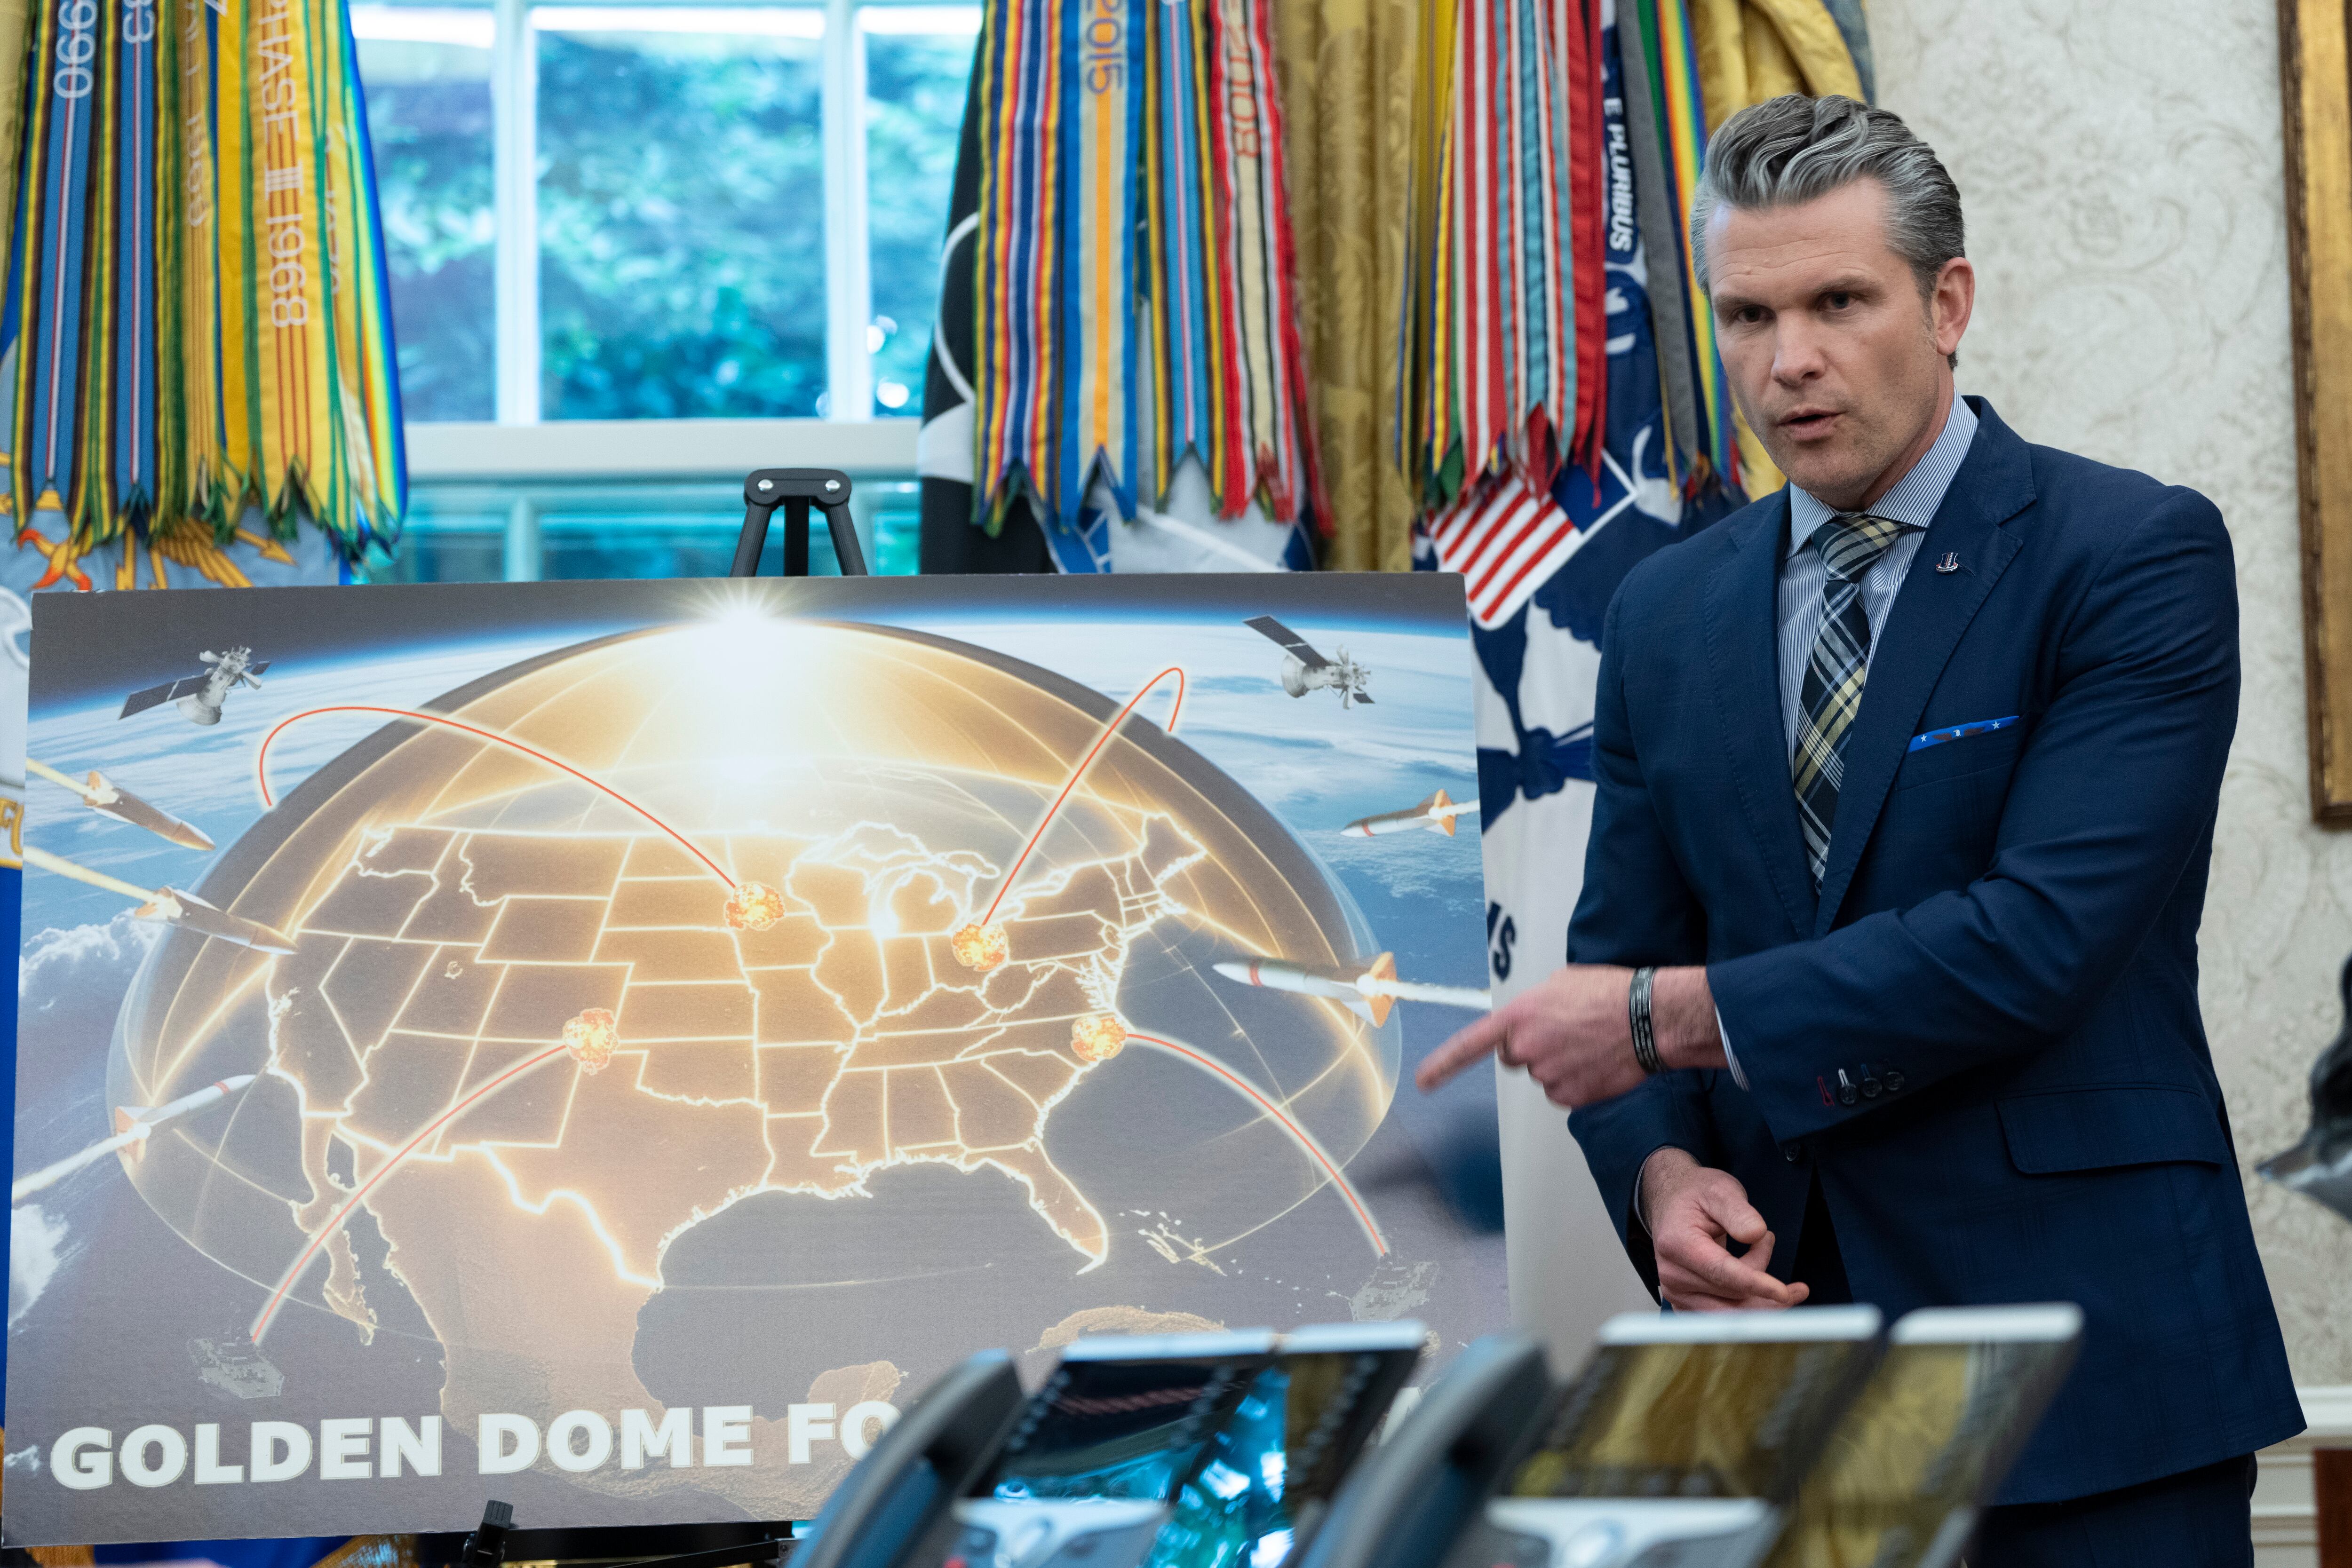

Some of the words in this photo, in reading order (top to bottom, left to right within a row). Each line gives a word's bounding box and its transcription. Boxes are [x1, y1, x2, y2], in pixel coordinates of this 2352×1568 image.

[1603, 97, 1623, 116] E
[1606, 124, 1633, 252] PLURIBUS
[265, 213, 309, 328] 1968
[50, 1415, 442, 1490] GOLDEN
[478, 1406, 754, 1474] DOME
